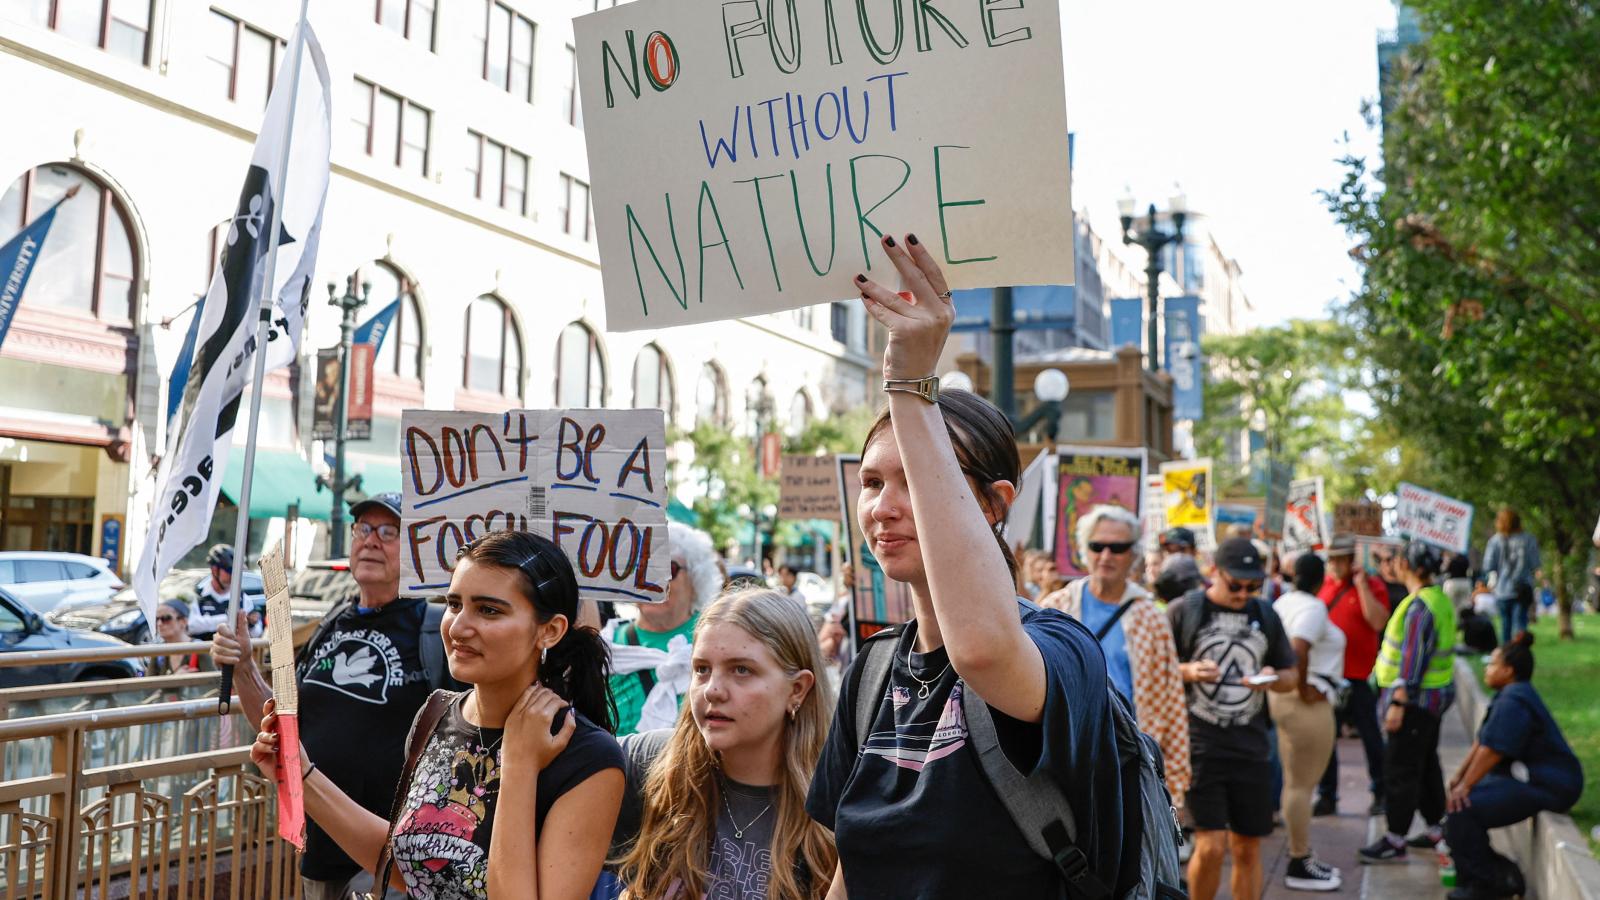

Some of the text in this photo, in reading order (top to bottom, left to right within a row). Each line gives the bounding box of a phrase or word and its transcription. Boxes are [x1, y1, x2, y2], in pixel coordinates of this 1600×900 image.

[601, 0, 1032, 108] NO FUTURE
[698, 71, 909, 169] WITHOUT
[625, 145, 998, 317] NATURE
[616, 435, 654, 494] A
[553, 509, 664, 594] FOOL
[367, 629, 393, 652] FOR
